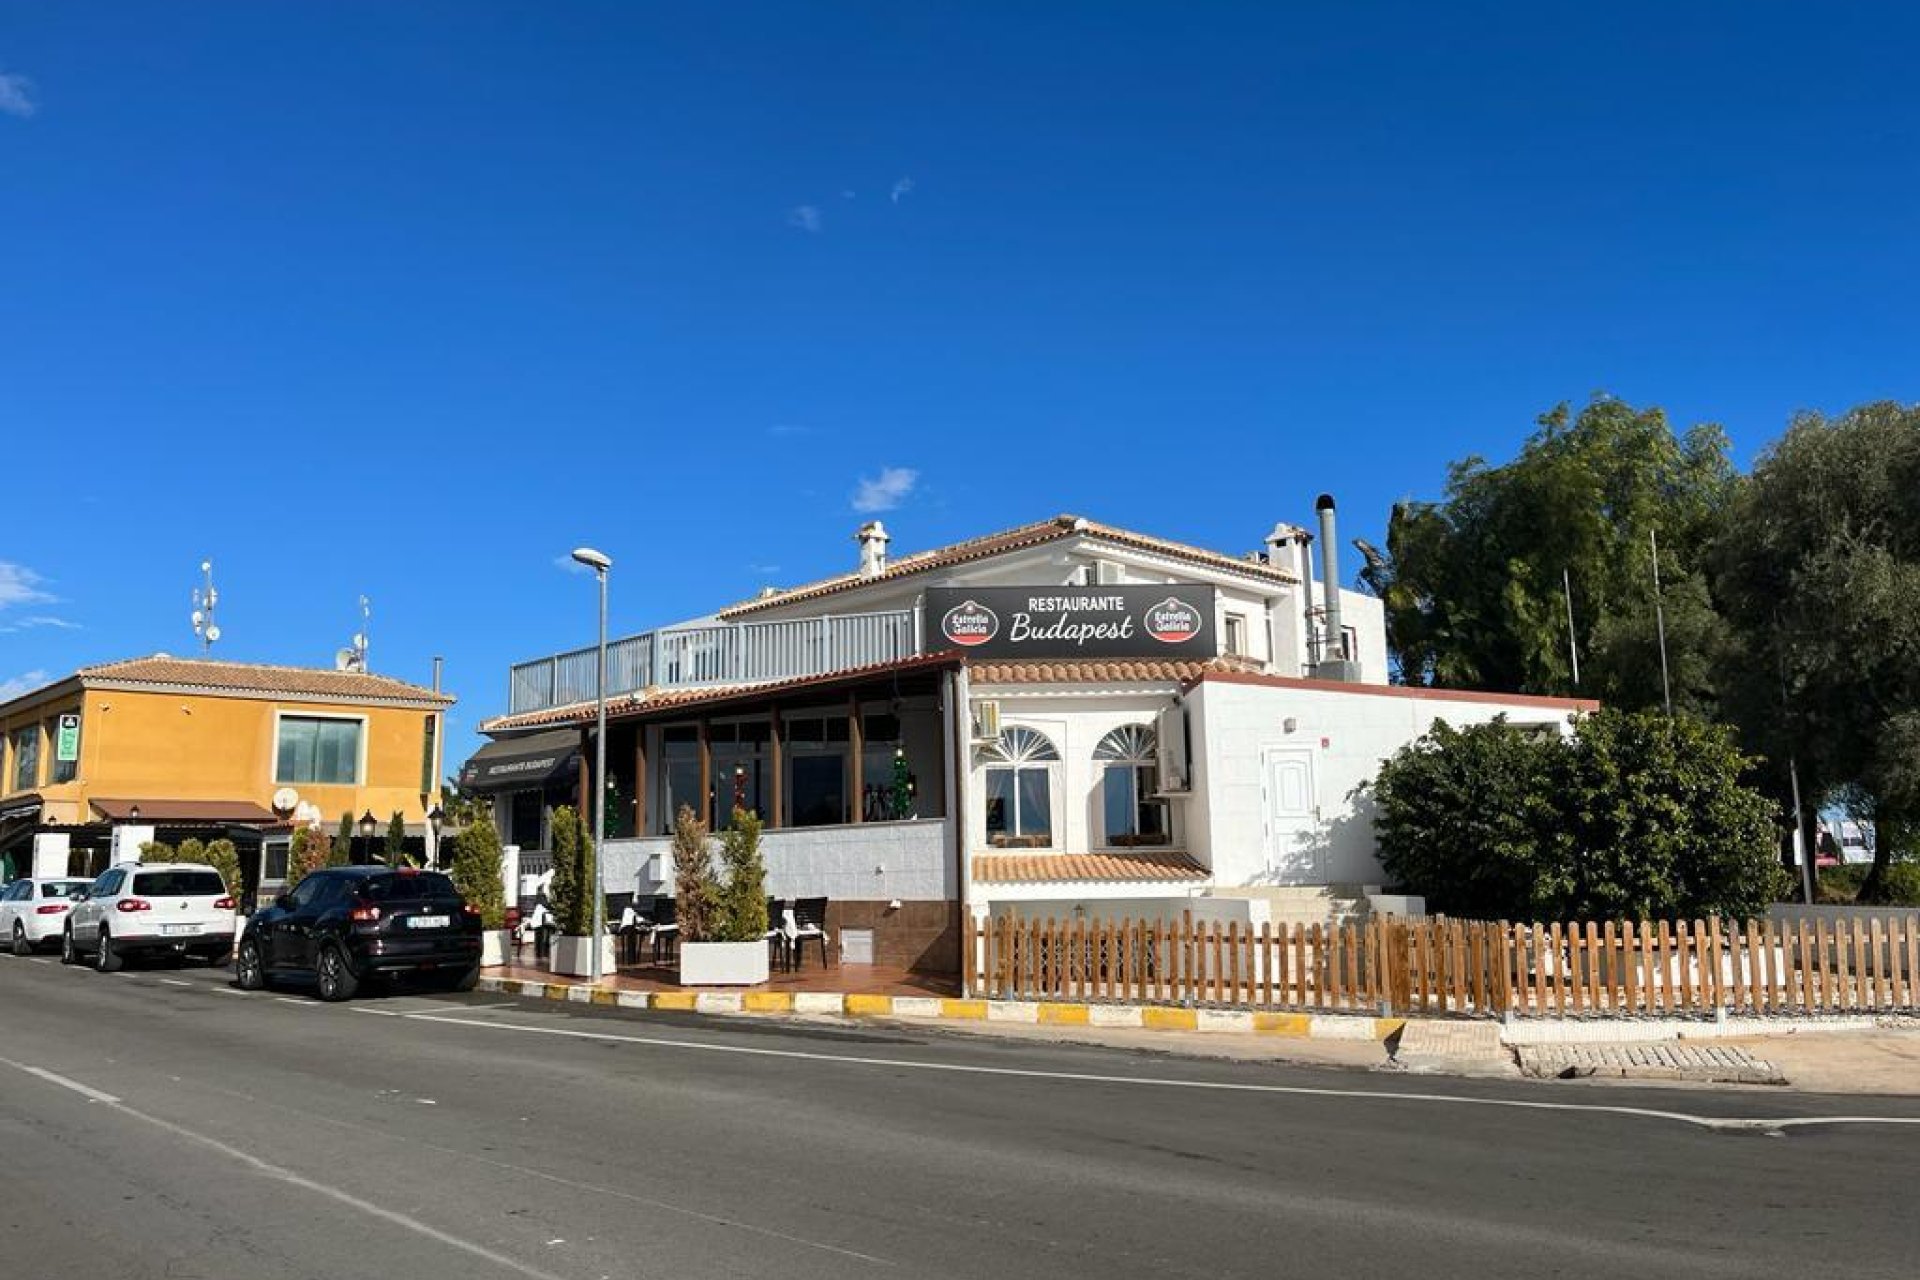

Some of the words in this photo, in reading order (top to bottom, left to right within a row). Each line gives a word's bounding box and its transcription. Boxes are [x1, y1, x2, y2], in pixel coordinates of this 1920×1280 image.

[1028, 596, 1124, 612] RESTAURANTE
[951, 613, 989, 625] Estrella
[1154, 610, 1191, 623] Estrella
[1010, 612, 1133, 645] Budapest
